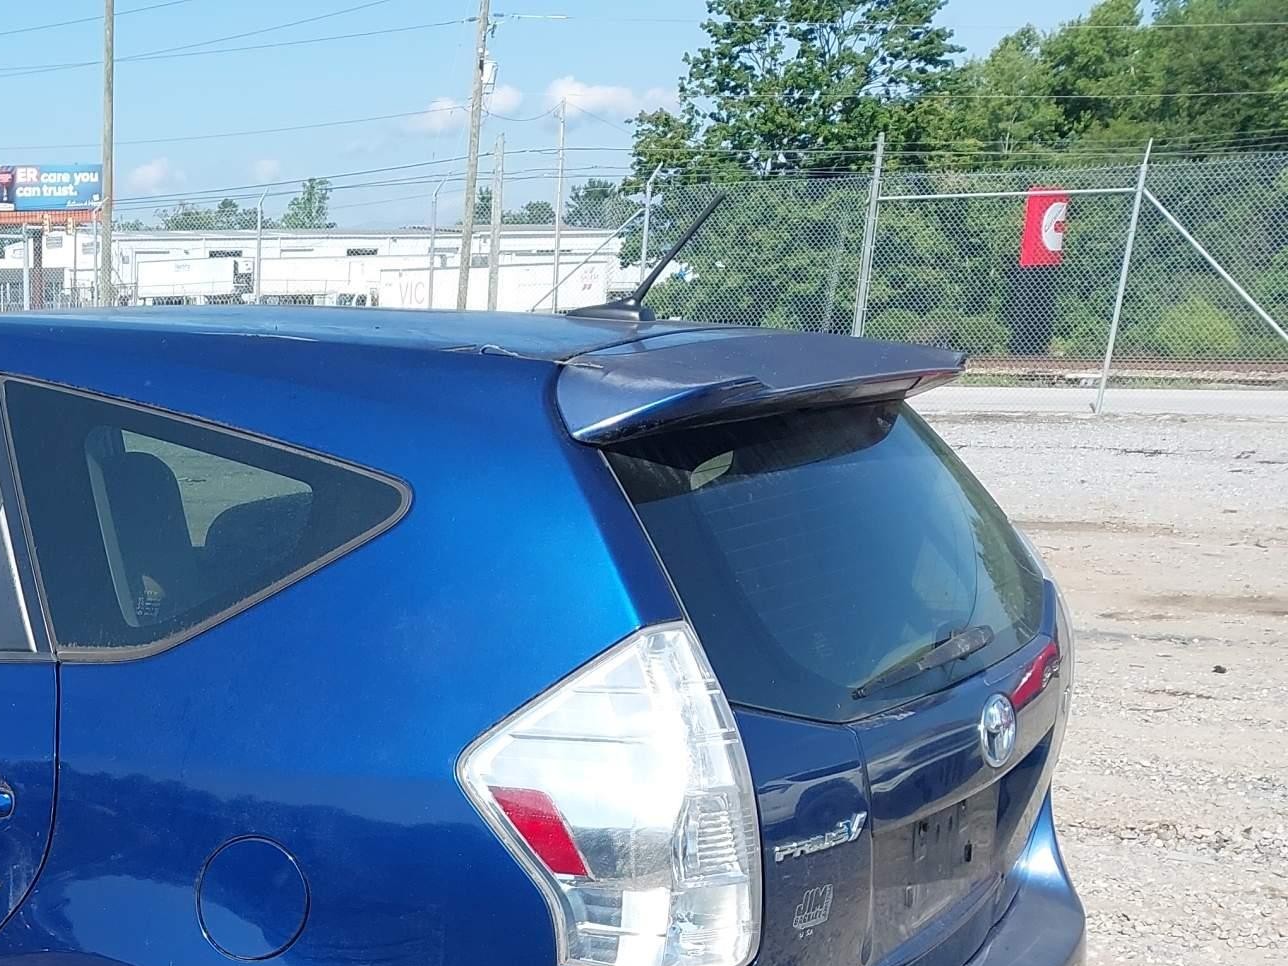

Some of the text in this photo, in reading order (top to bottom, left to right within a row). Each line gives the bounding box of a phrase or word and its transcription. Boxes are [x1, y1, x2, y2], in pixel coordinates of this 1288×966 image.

[15, 167, 99, 186] ER care you
[15, 184, 78, 197] can trust.
